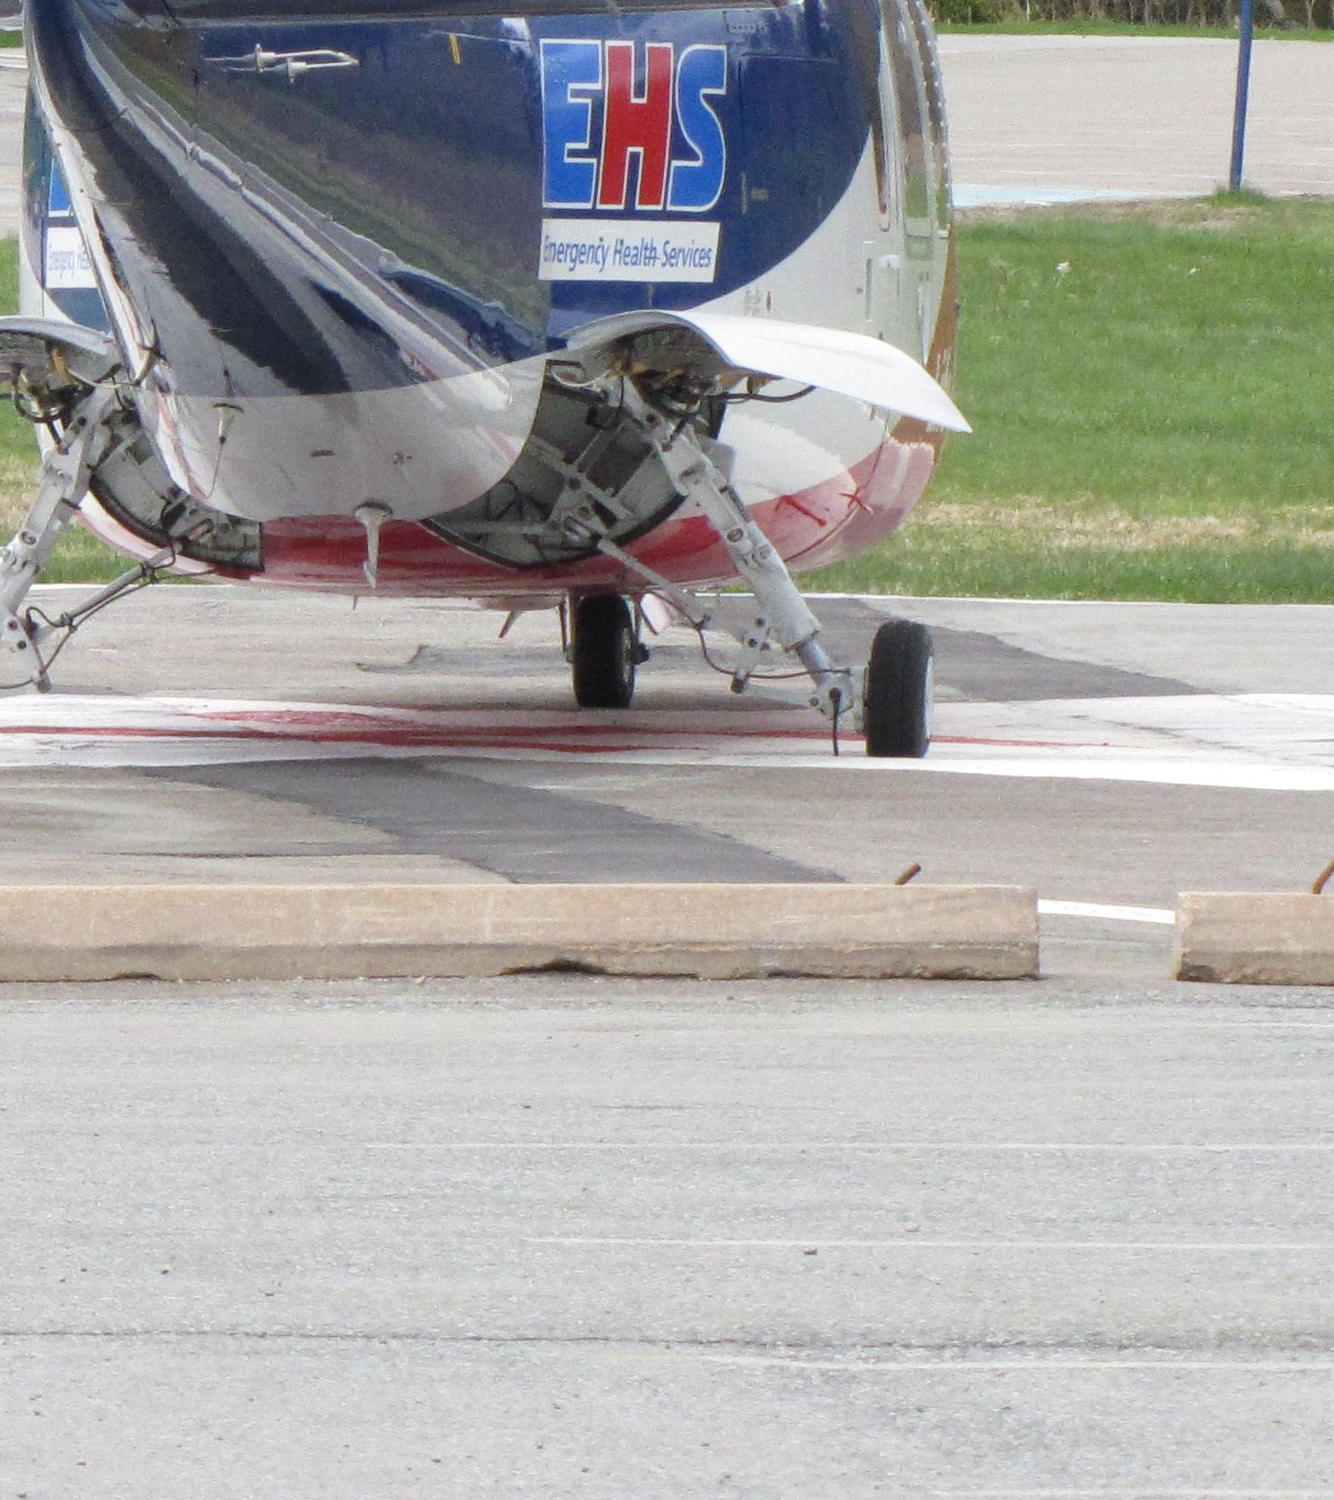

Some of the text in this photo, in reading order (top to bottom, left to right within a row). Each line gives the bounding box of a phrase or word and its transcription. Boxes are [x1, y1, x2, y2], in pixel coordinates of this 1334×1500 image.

[539, 38, 728, 212] EHS
[612, 237, 657, 267] Health
[661, 239, 713, 268] Services
